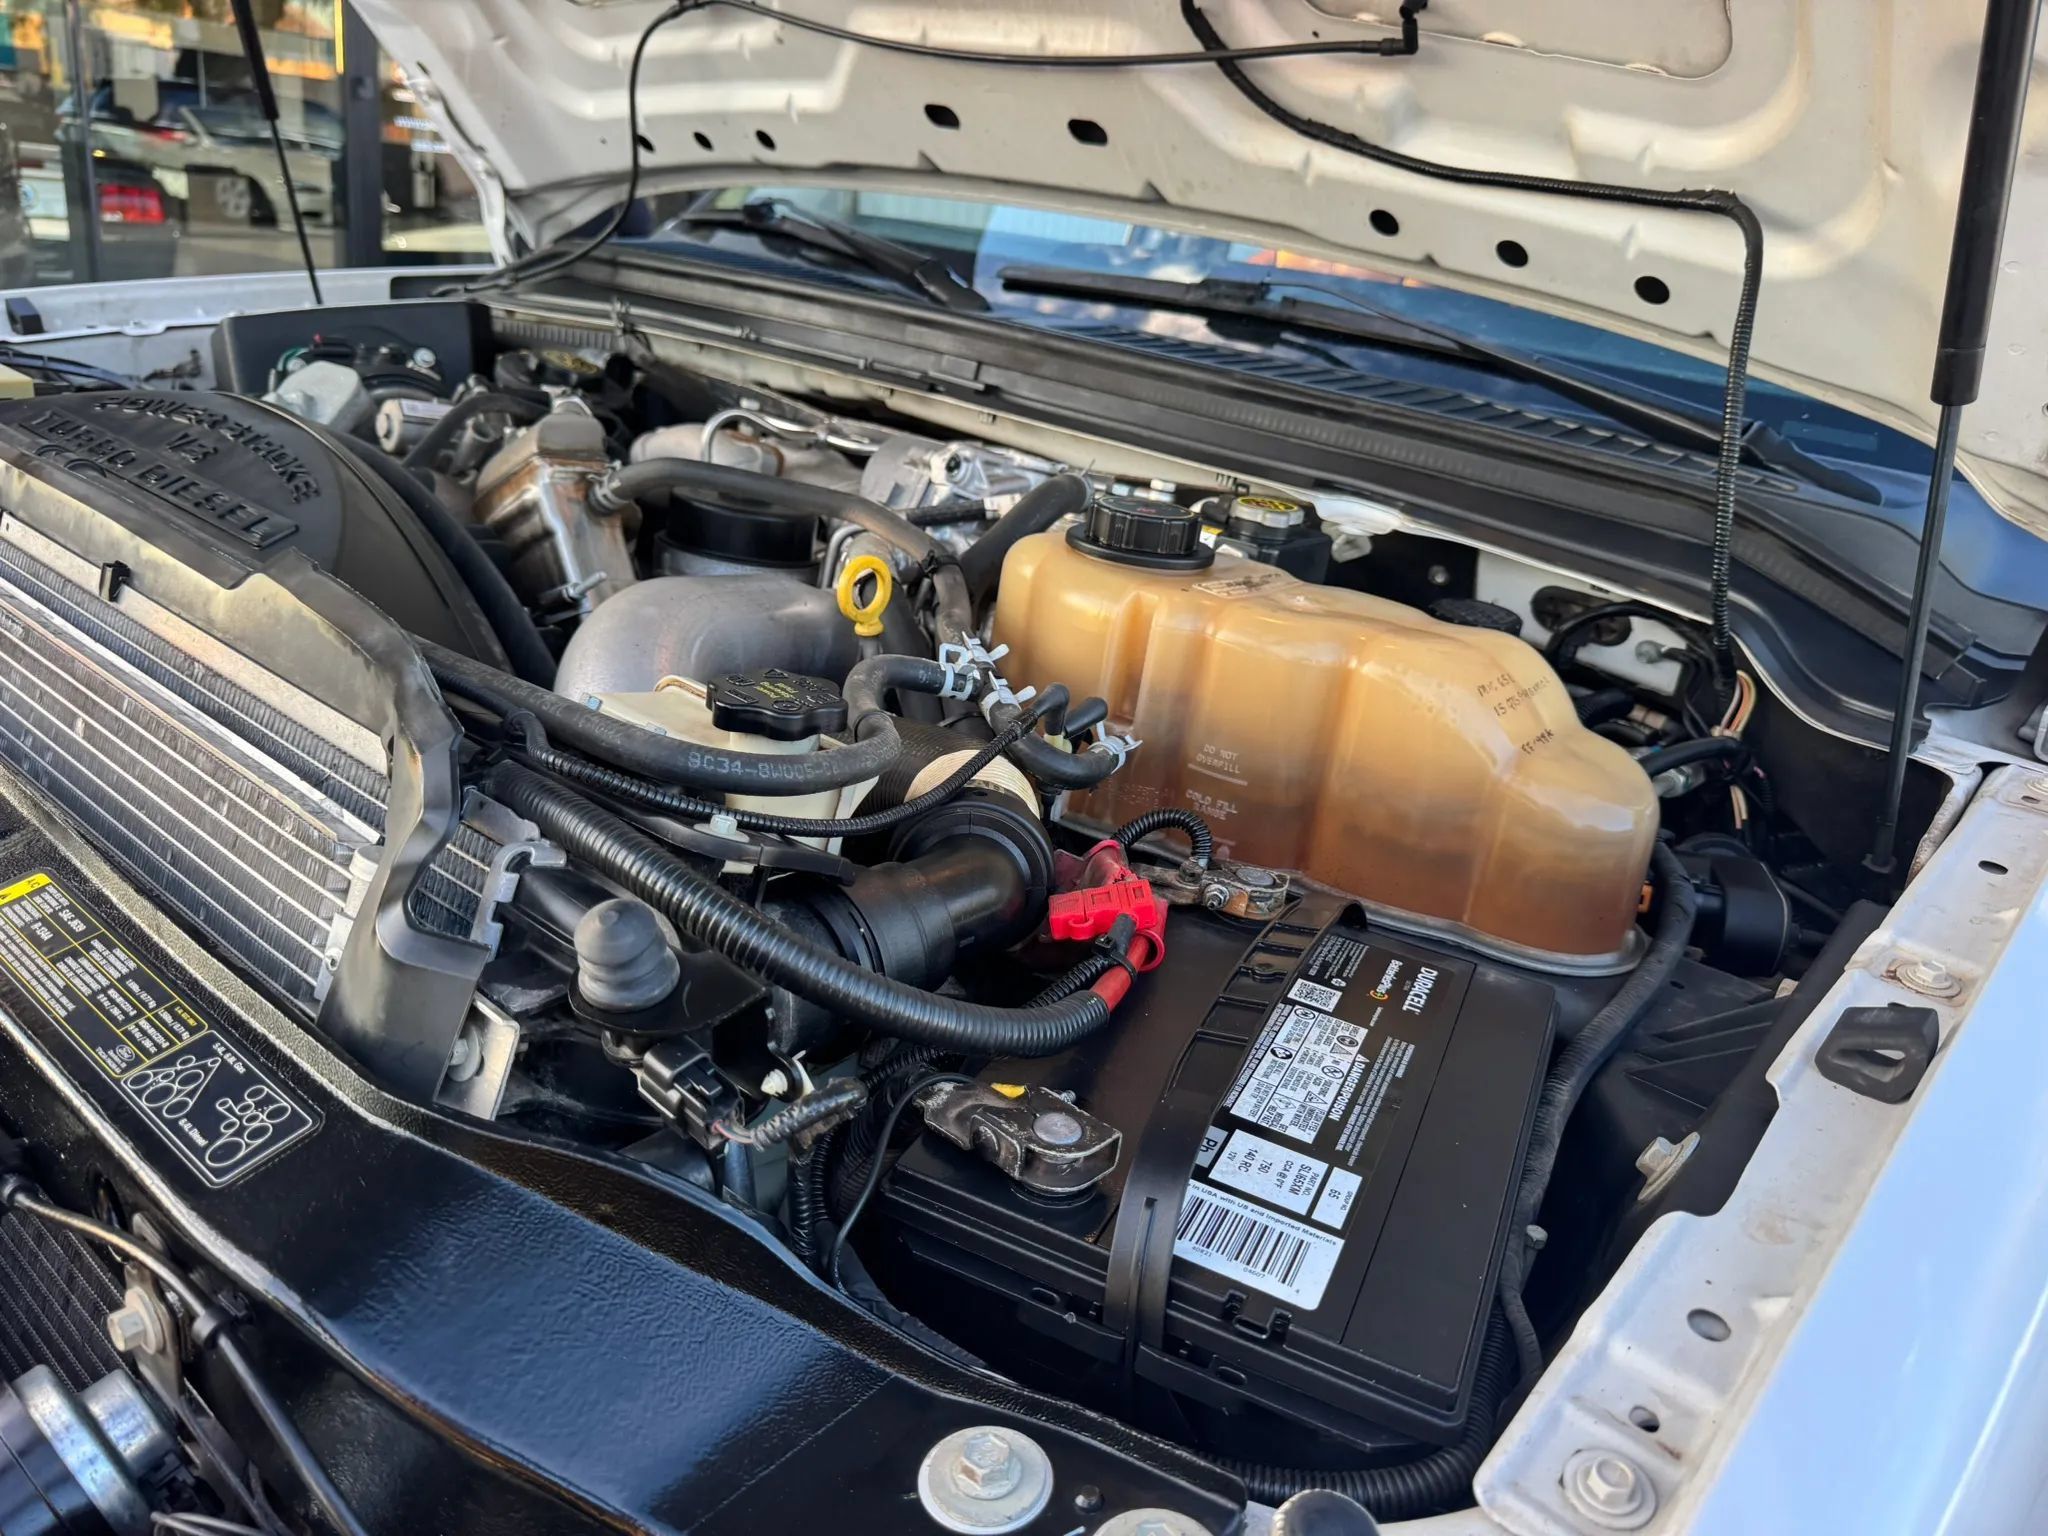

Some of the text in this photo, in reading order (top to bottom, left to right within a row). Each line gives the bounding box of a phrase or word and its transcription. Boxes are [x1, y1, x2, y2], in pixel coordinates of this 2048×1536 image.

[29, 412, 272, 540] TURBO DIESEL
[1203, 744, 1240, 761] DO NOT
[1195, 753, 1241, 775] OVERFILL
[1185, 789, 1212, 805] COLD
[1216, 799, 1238, 814] FILL
[57, 908, 75, 921] SAE
[1401, 966, 1438, 1013] DURACELL
[232, 1061, 248, 1074] Gas
[1327, 1061, 1365, 1121] DANGER/POISON
[187, 1128, 209, 1147] Diesel
[1226, 1150, 1237, 1161] 12V
[1237, 1147, 1258, 1173] 140 RC
[1281, 1159, 1293, 1172] CCA
[1257, 1159, 1272, 1174] 750
[1276, 1170, 1288, 1179] @
[1287, 1163, 1312, 1195] SLI65XM
[1301, 1171, 1319, 1198] PART NO.
[1327, 1188, 1341, 1199] 65
[1219, 1195, 1236, 1205] with
[1249, 1207, 1265, 1217] and
[1301, 1228, 1337, 1246] Materials
